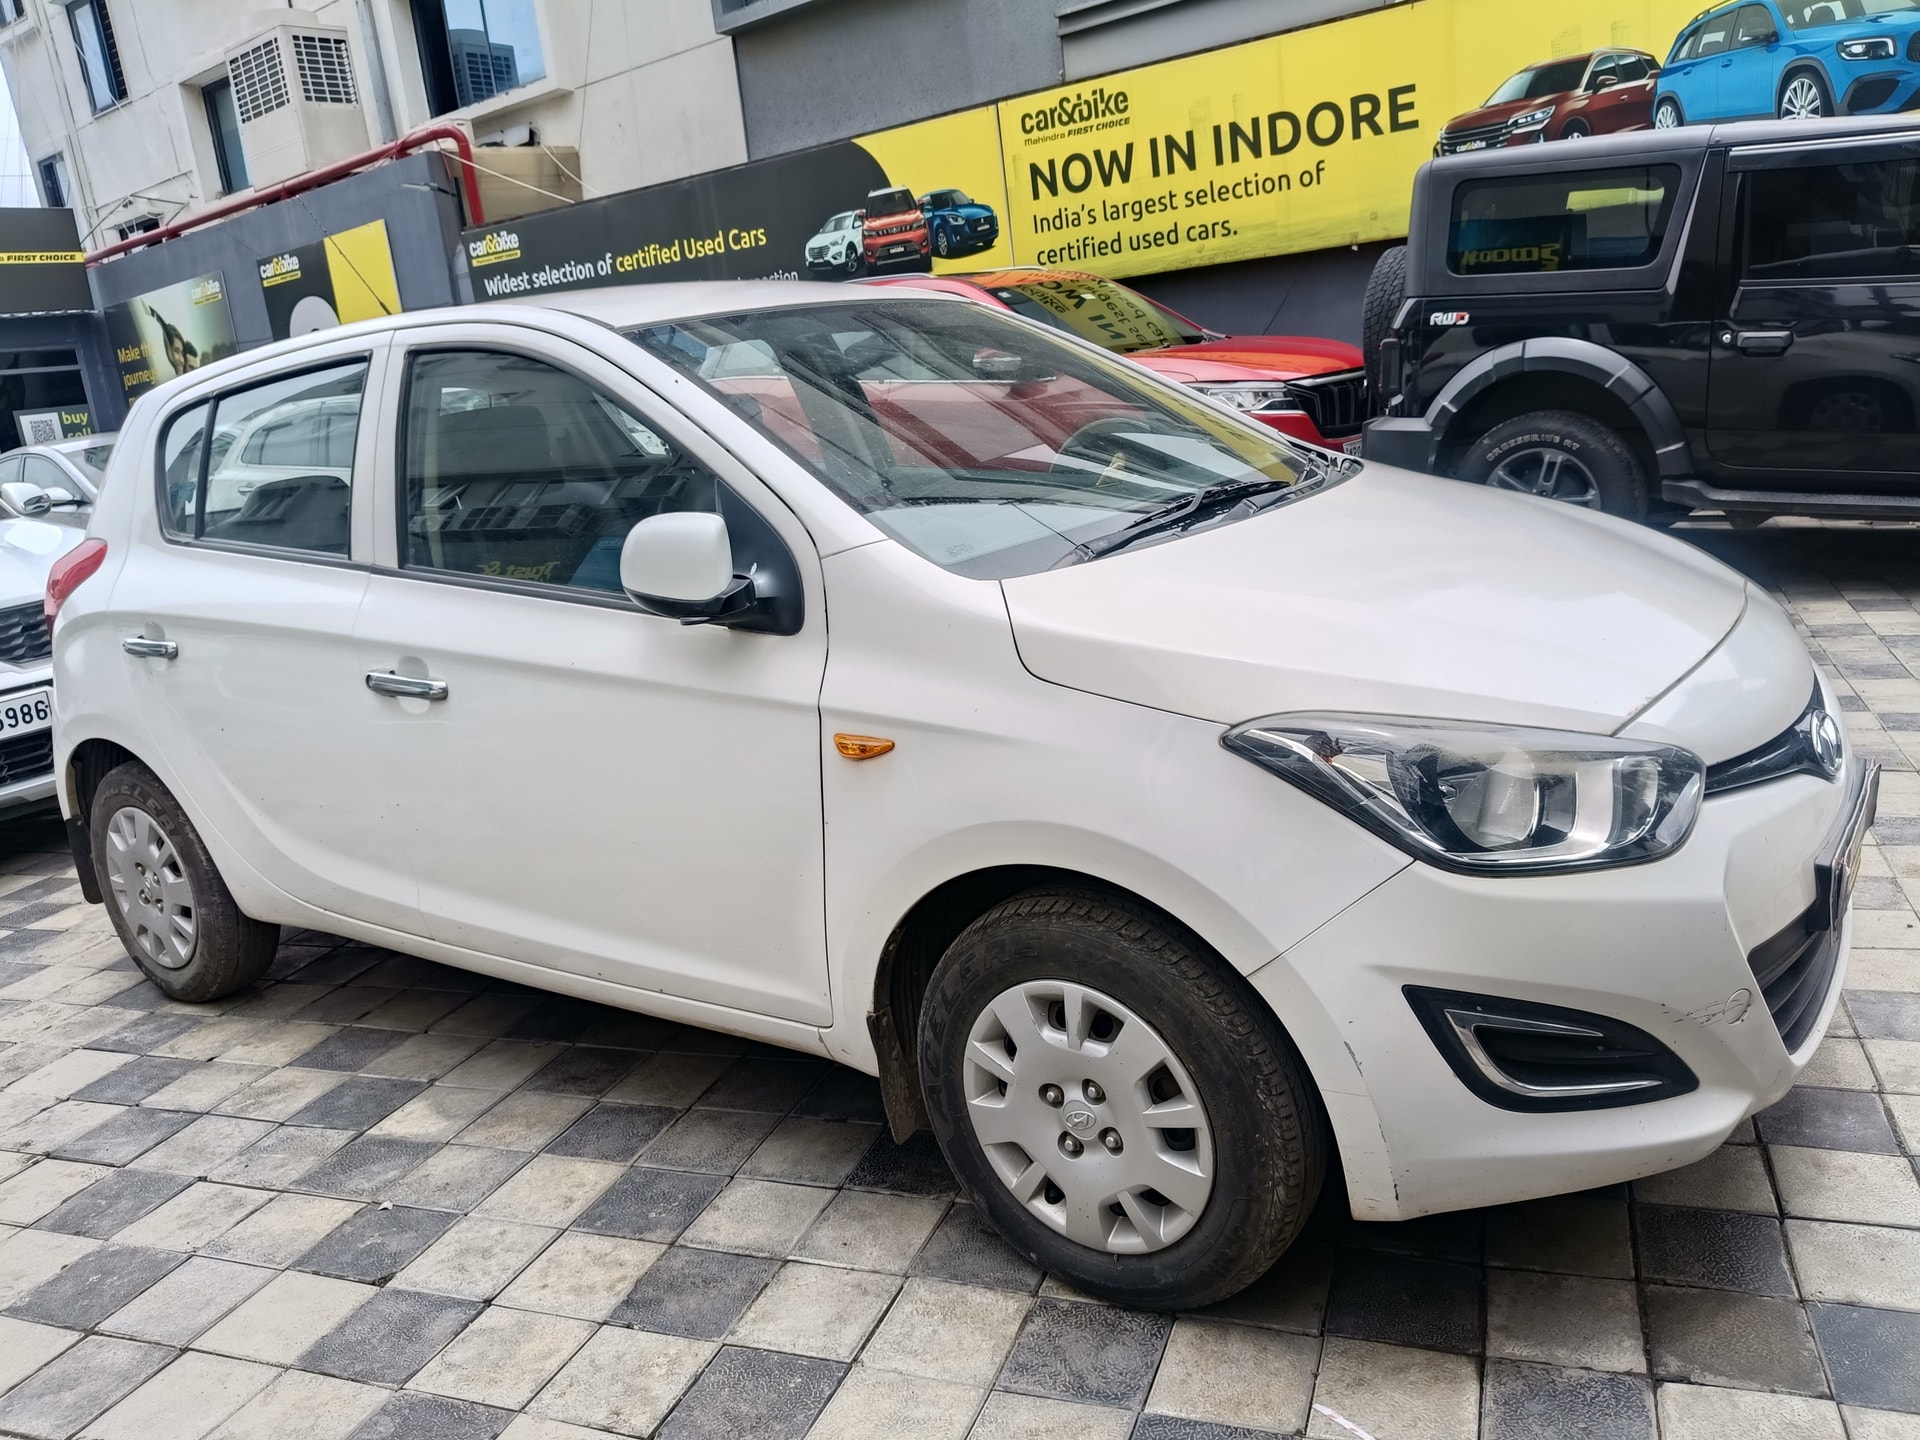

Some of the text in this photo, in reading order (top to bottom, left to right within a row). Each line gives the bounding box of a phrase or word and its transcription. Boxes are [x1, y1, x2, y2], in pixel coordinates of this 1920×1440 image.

[1021, 88, 1129, 135] car&bike
[1025, 117, 1131, 147] Mahindra FIRST CHOICE
[1029, 83, 1420, 201] NOW IN INDORE
[1033, 160, 1325, 234] India's largest selection of
[469, 230, 519, 257] car&bike
[1037, 219, 1239, 266] certified used cars.
[7, 254, 37, 262] FIRST
[39, 254, 76, 262] CHOICE
[260, 253, 300, 279] car&bike
[484, 228, 767, 296] Widest selection of certified Used Cars
[1430, 311, 1470, 326] RWD
[117, 344, 141, 364] Make
[122, 368, 158, 391] journey
[62, 410, 88, 426] buy
